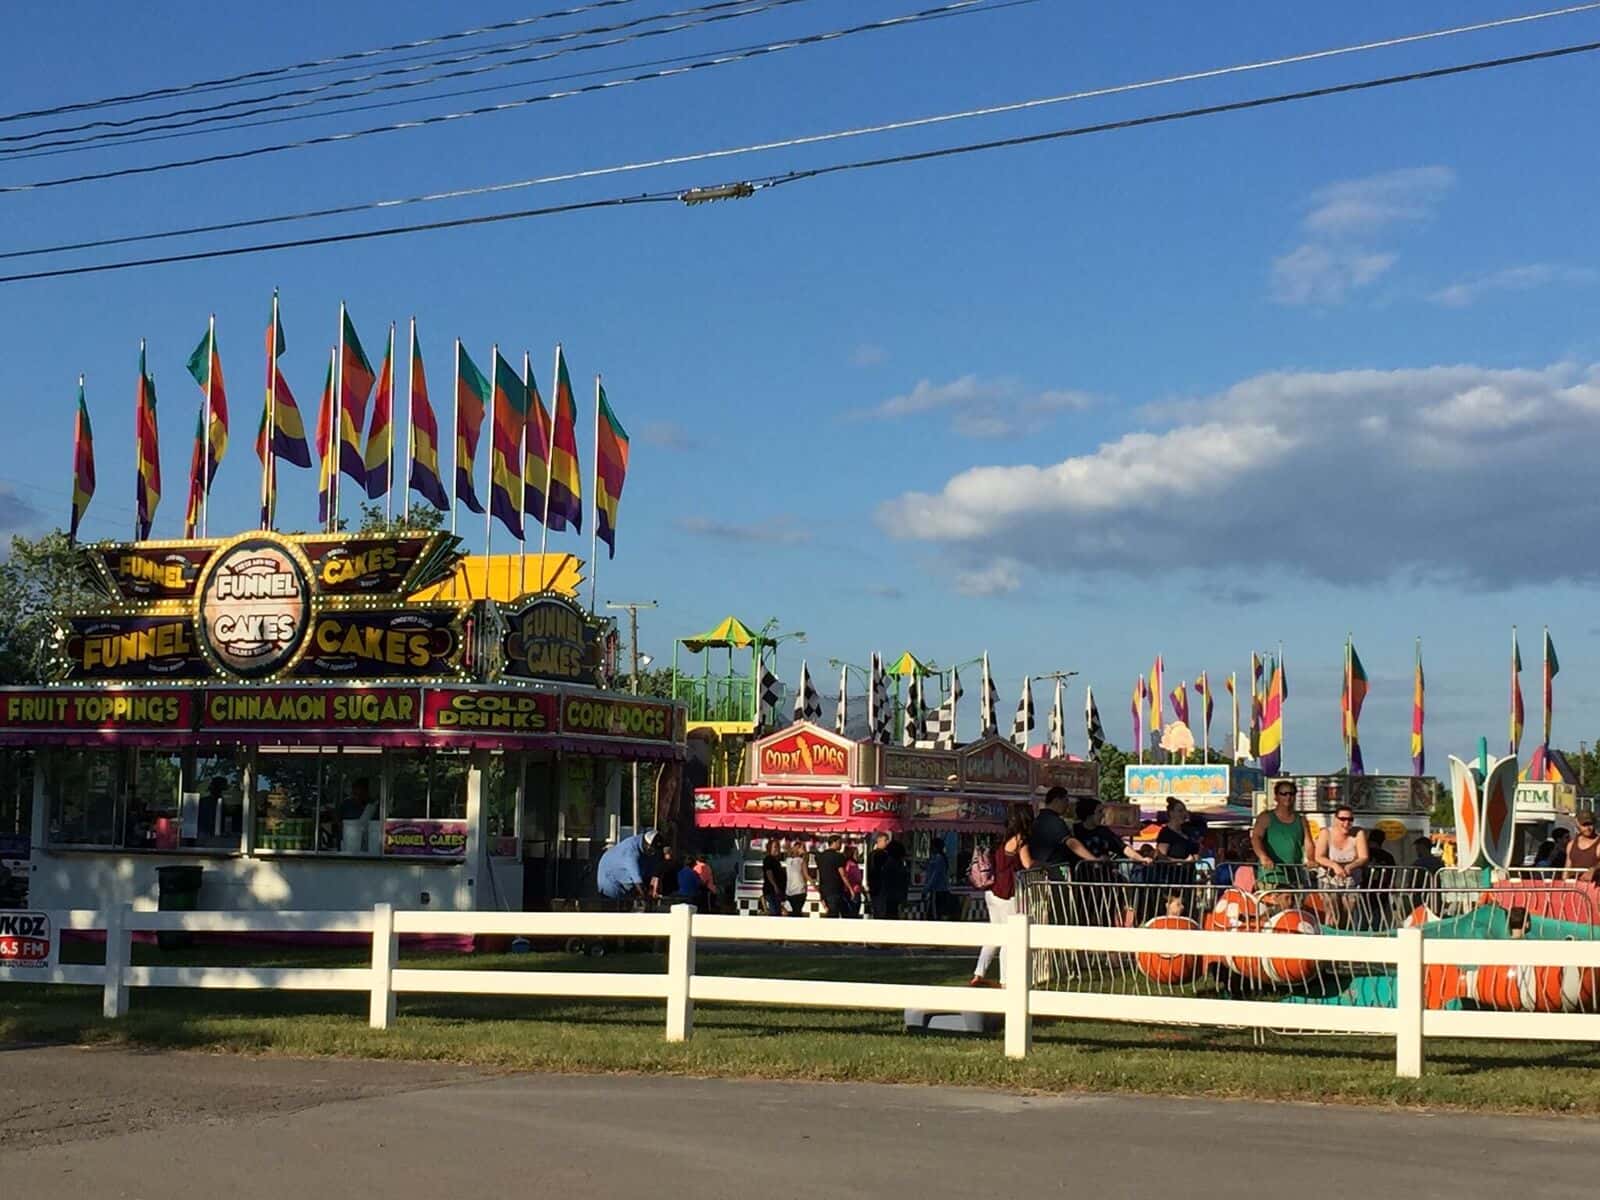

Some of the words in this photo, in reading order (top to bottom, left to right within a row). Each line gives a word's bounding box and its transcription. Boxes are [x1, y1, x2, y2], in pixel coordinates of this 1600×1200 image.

[120, 556, 187, 589] FUNNEL
[322, 547, 397, 585] CAKES
[217, 572, 298, 599] FUNNEL
[214, 614, 295, 642] CAKES
[522, 607, 585, 648] FUNNEL
[83, 622, 190, 671] FUNNEL
[316, 619, 430, 667] CAKES
[527, 642, 581, 677] CAKES
[7, 697, 69, 721] FRUIT
[74, 696, 179, 723] TOPPINGS
[210, 695, 326, 721] CINNAMON
[333, 695, 413, 721] SUGAR
[451, 695, 537, 713] COLD
[438, 710, 545, 728] DRINKS
[567, 701, 616, 729] CORN
[620, 705, 665, 736] DOGS
[765, 749, 800, 771] CORN
[812, 744, 845, 770] DOGS
[428, 834, 465, 847] CAKES
[23, 943, 44, 956] FM
